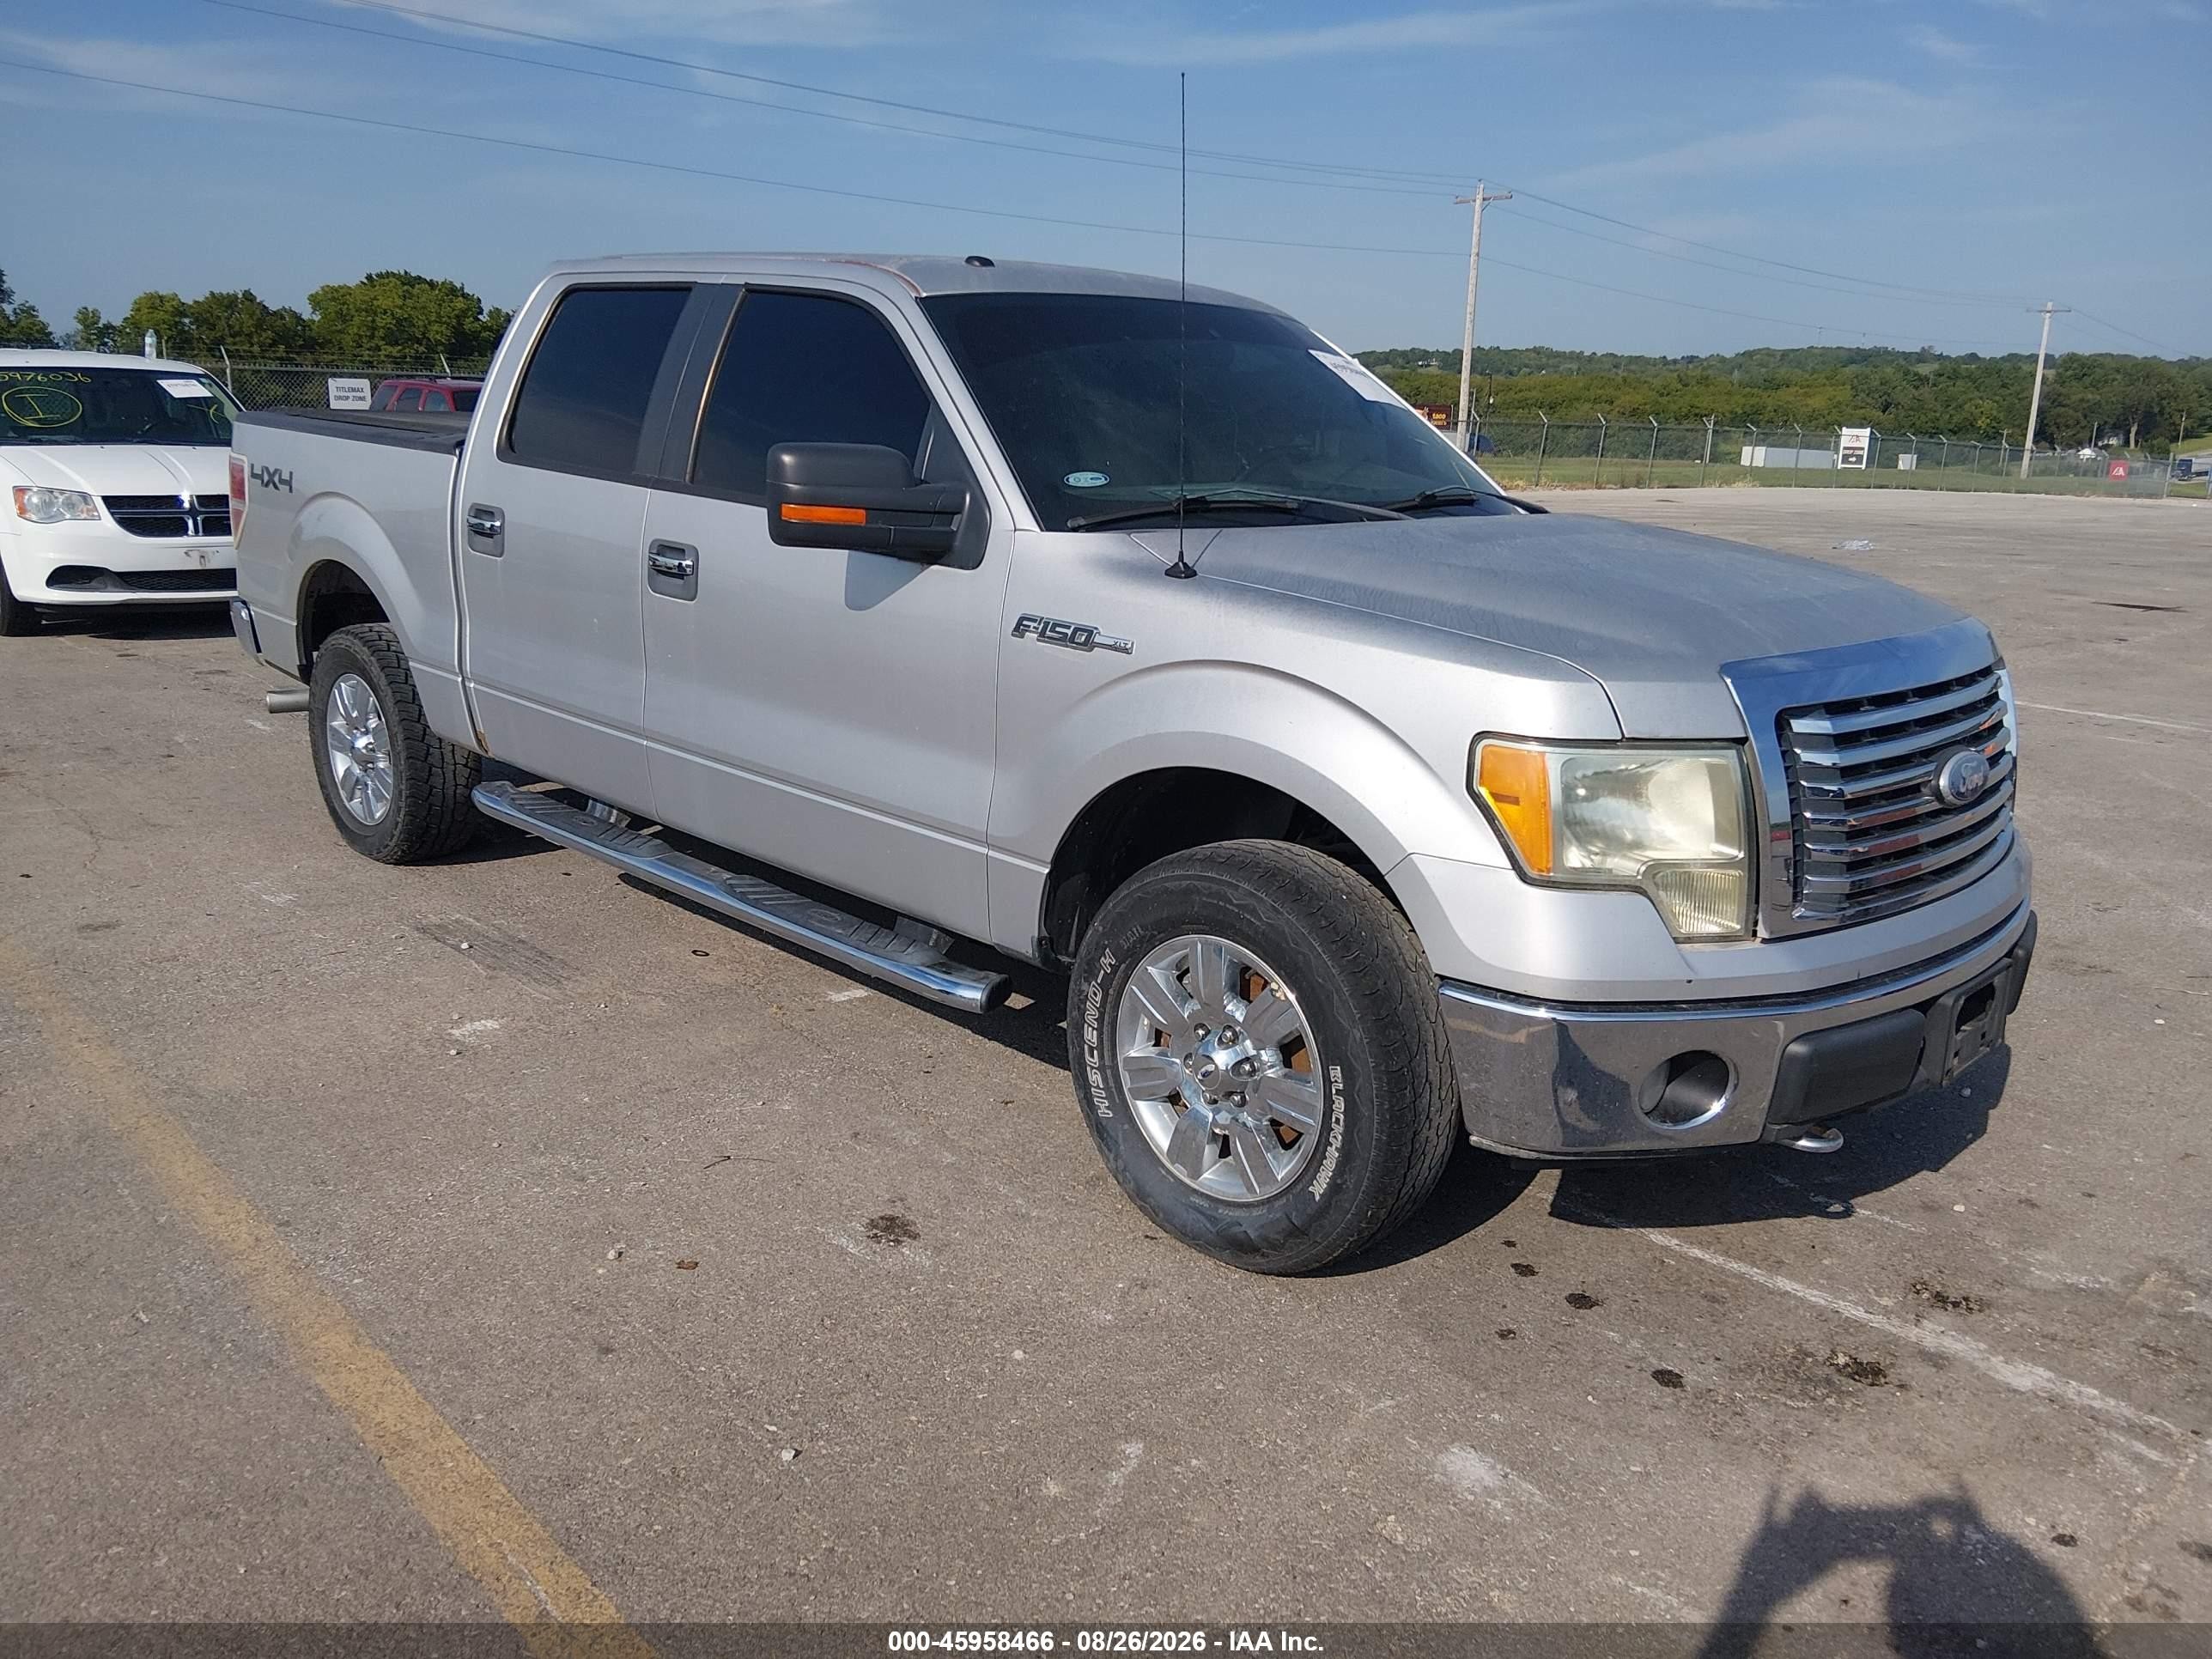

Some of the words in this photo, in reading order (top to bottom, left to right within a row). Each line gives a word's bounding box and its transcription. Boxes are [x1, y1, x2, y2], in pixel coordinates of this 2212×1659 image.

[1958, 760, 1985, 794] Ford
[1084, 947, 1116, 1118] HISCEND-H
[1308, 1066, 1346, 1202] BLACKHAWK
